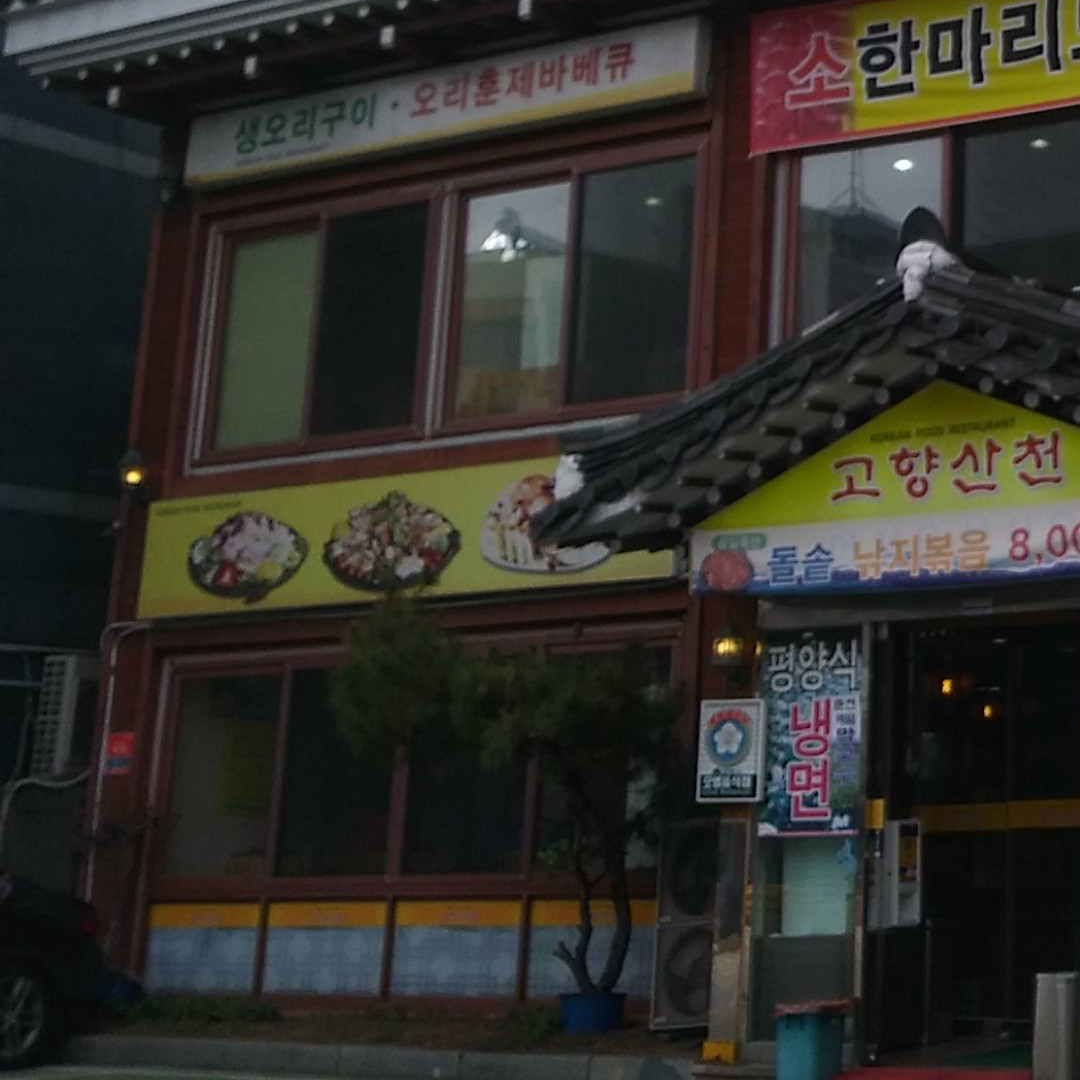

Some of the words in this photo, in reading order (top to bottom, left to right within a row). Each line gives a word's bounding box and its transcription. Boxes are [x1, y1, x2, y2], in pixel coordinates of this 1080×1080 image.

[234, 92, 380, 156] 생오리구이
[409, 40, 636, 118] 오리훈제바베큐
[830, 431, 1064, 503] 고향산천
[767, 542, 835, 585] 돌솥
[768, 638, 857, 692] 평양식
[788, 696, 832, 821] 냉면
